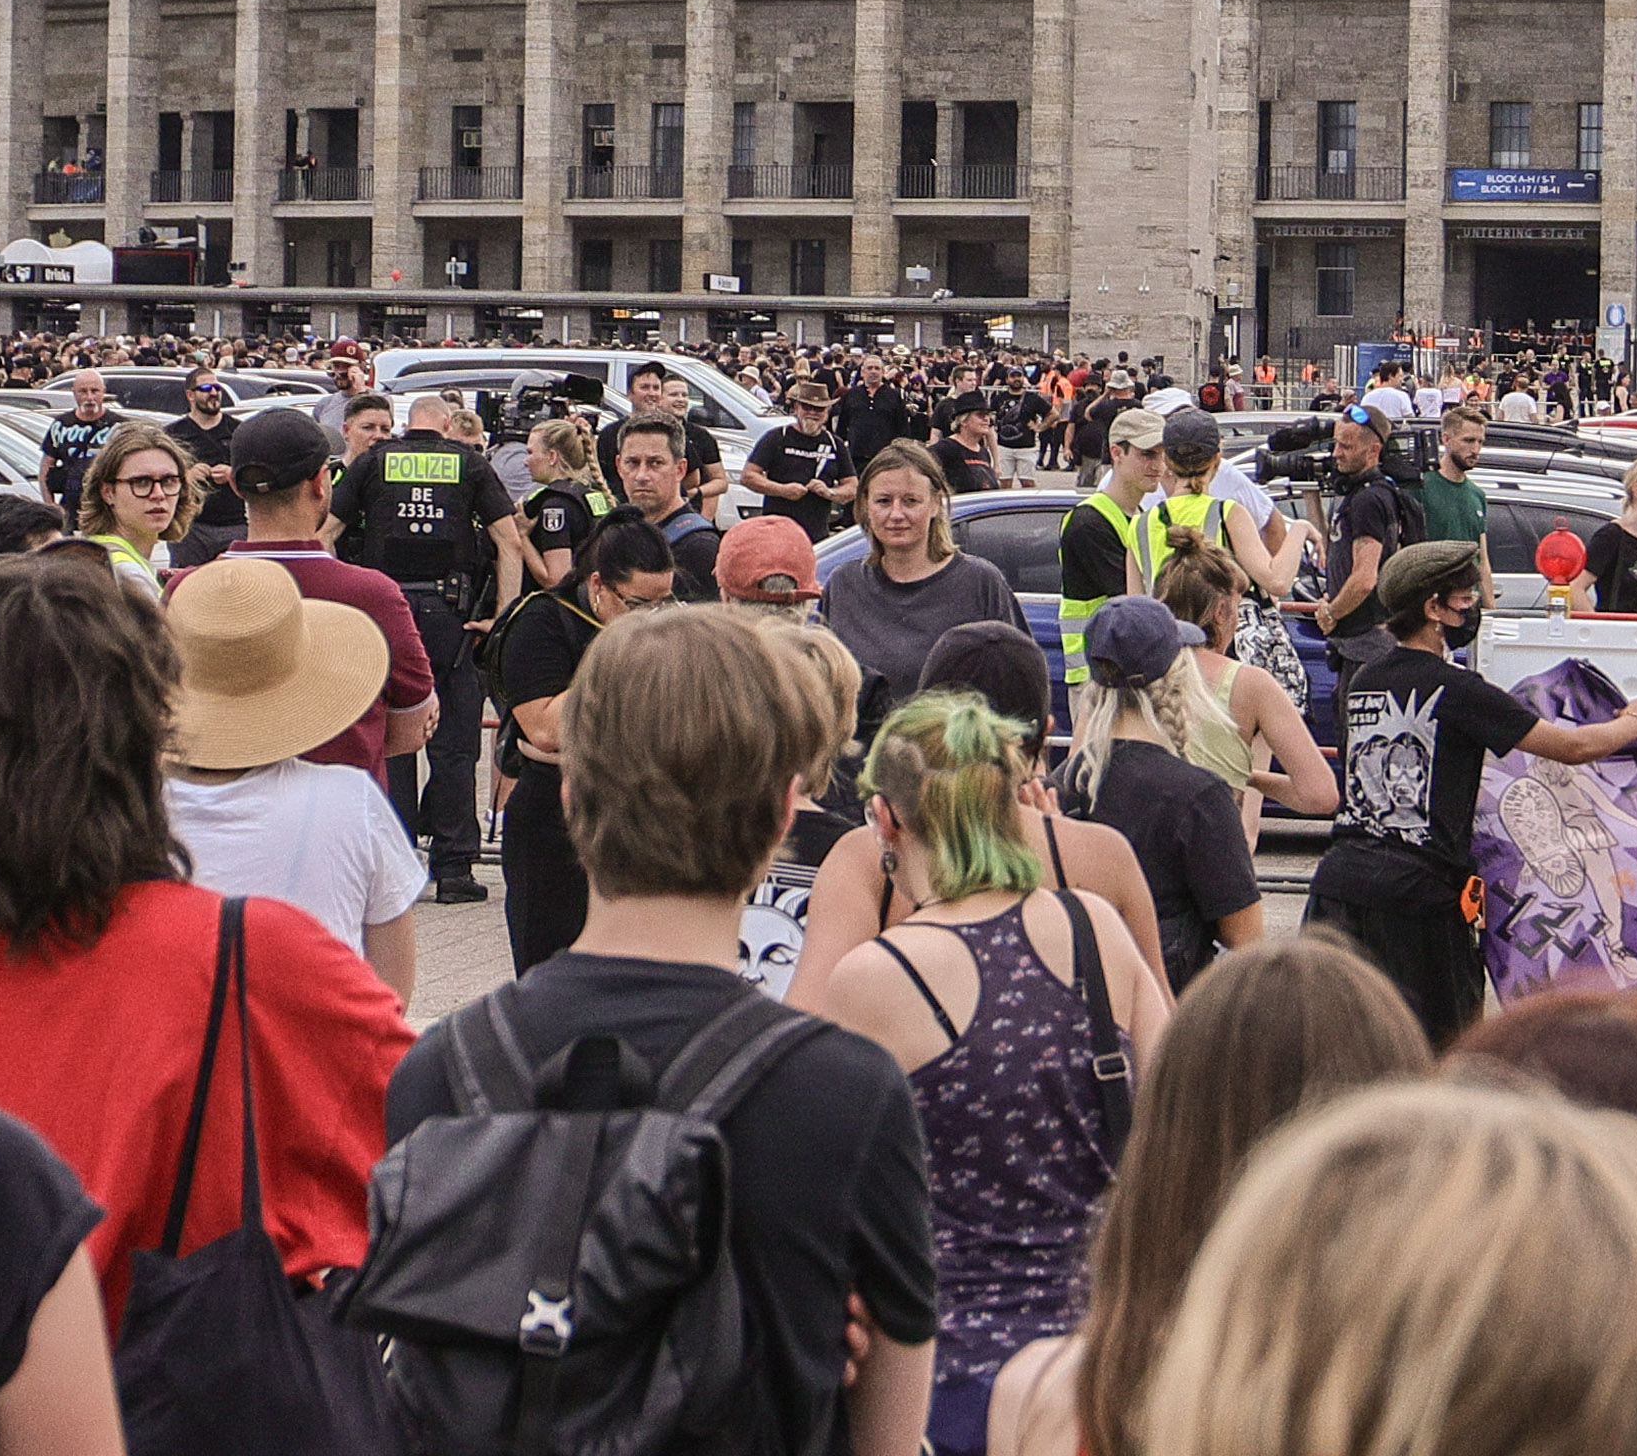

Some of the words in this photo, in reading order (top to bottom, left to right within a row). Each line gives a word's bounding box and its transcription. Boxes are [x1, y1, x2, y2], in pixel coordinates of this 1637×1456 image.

[1486, 175, 1517, 184] BLOCK
[1481, 185, 1512, 194] BLOCK
[1463, 227, 1532, 239] UNTERRING
[387, 455, 459, 481] POLIZEI
[410, 487, 434, 503] BE
[397, 503, 445, 520] 2331a
